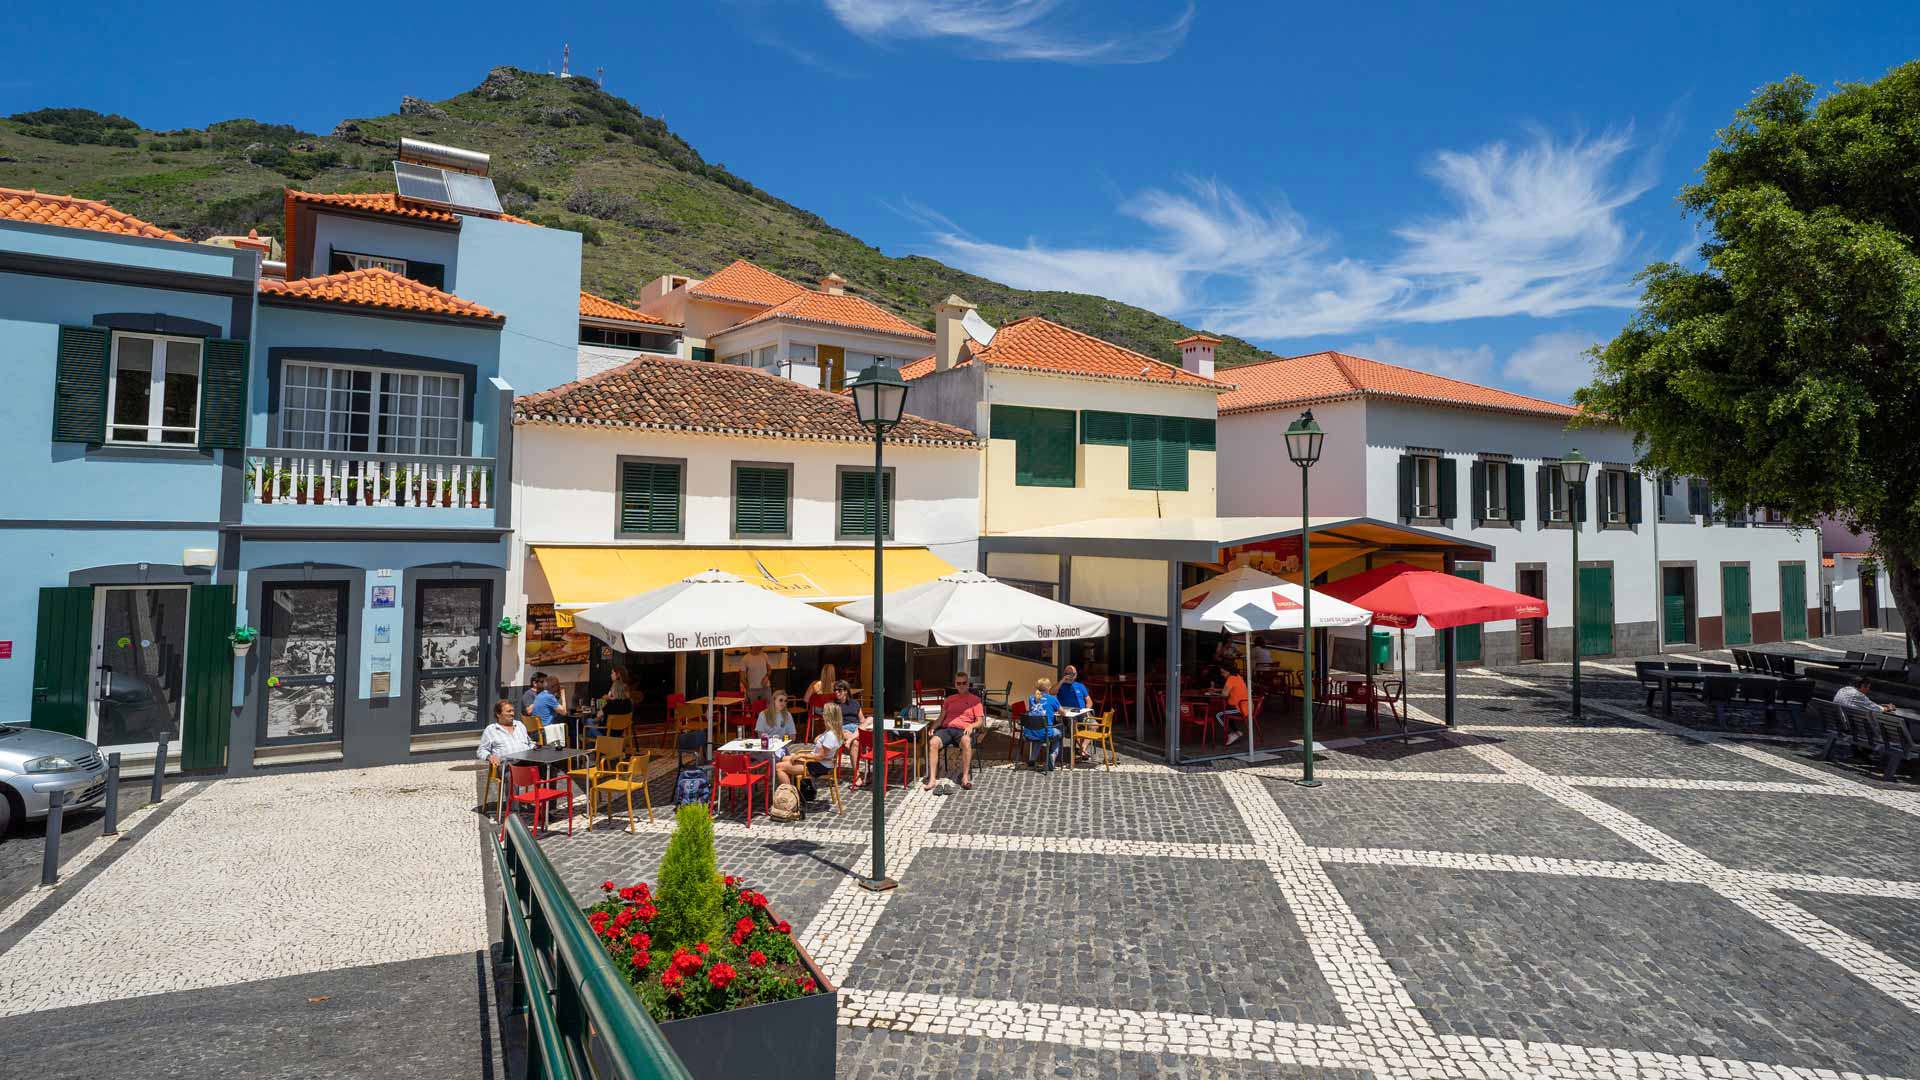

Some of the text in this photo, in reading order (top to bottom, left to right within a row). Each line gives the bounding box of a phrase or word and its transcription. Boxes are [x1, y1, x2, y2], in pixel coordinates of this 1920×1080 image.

[1037, 624, 1080, 638] Bar Xenica
[667, 631, 731, 649] Bar Xenica
